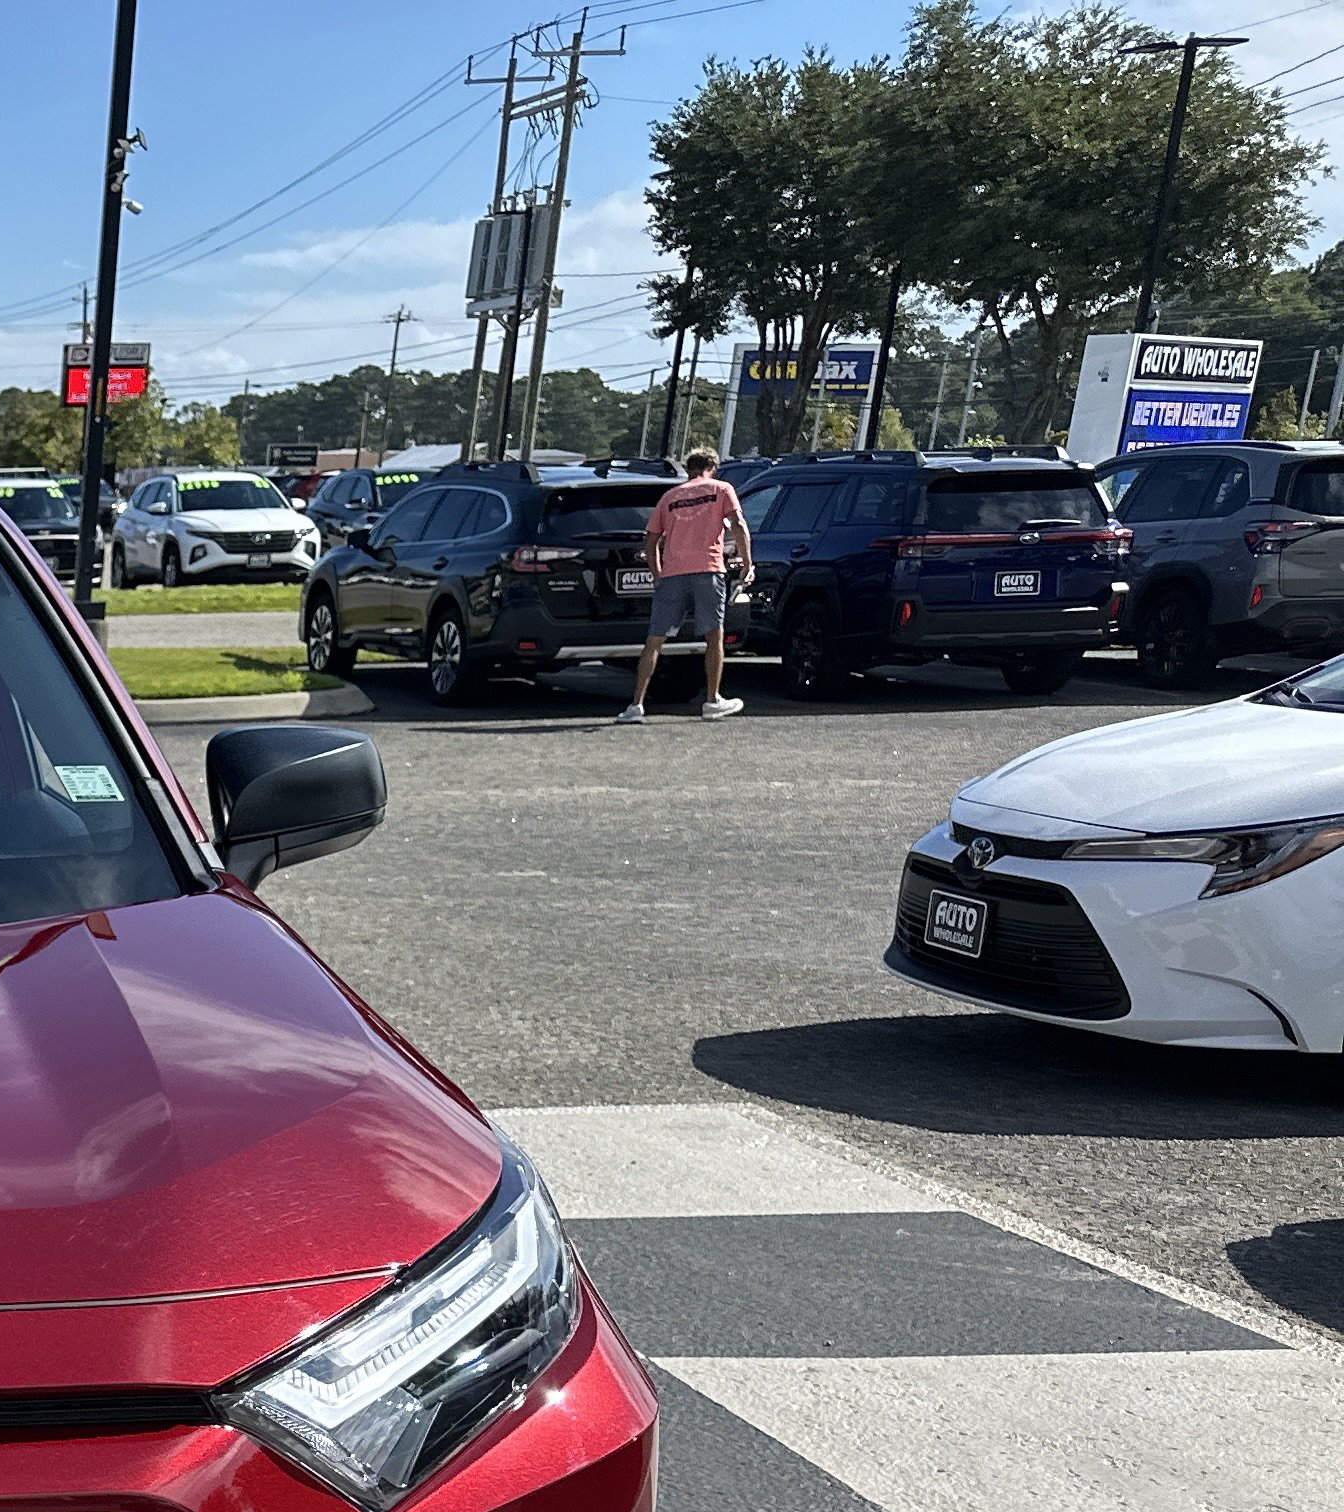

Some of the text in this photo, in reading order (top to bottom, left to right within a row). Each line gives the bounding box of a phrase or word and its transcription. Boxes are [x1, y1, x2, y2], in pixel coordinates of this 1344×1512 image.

[1140, 345, 1257, 378] AUTO WHOLESALE
[1132, 401, 1241, 427] BETTER VEHICLES
[622, 572, 654, 584] AUTO
[1002, 575, 1034, 586] AUTO
[935, 901, 977, 932] AUTO
